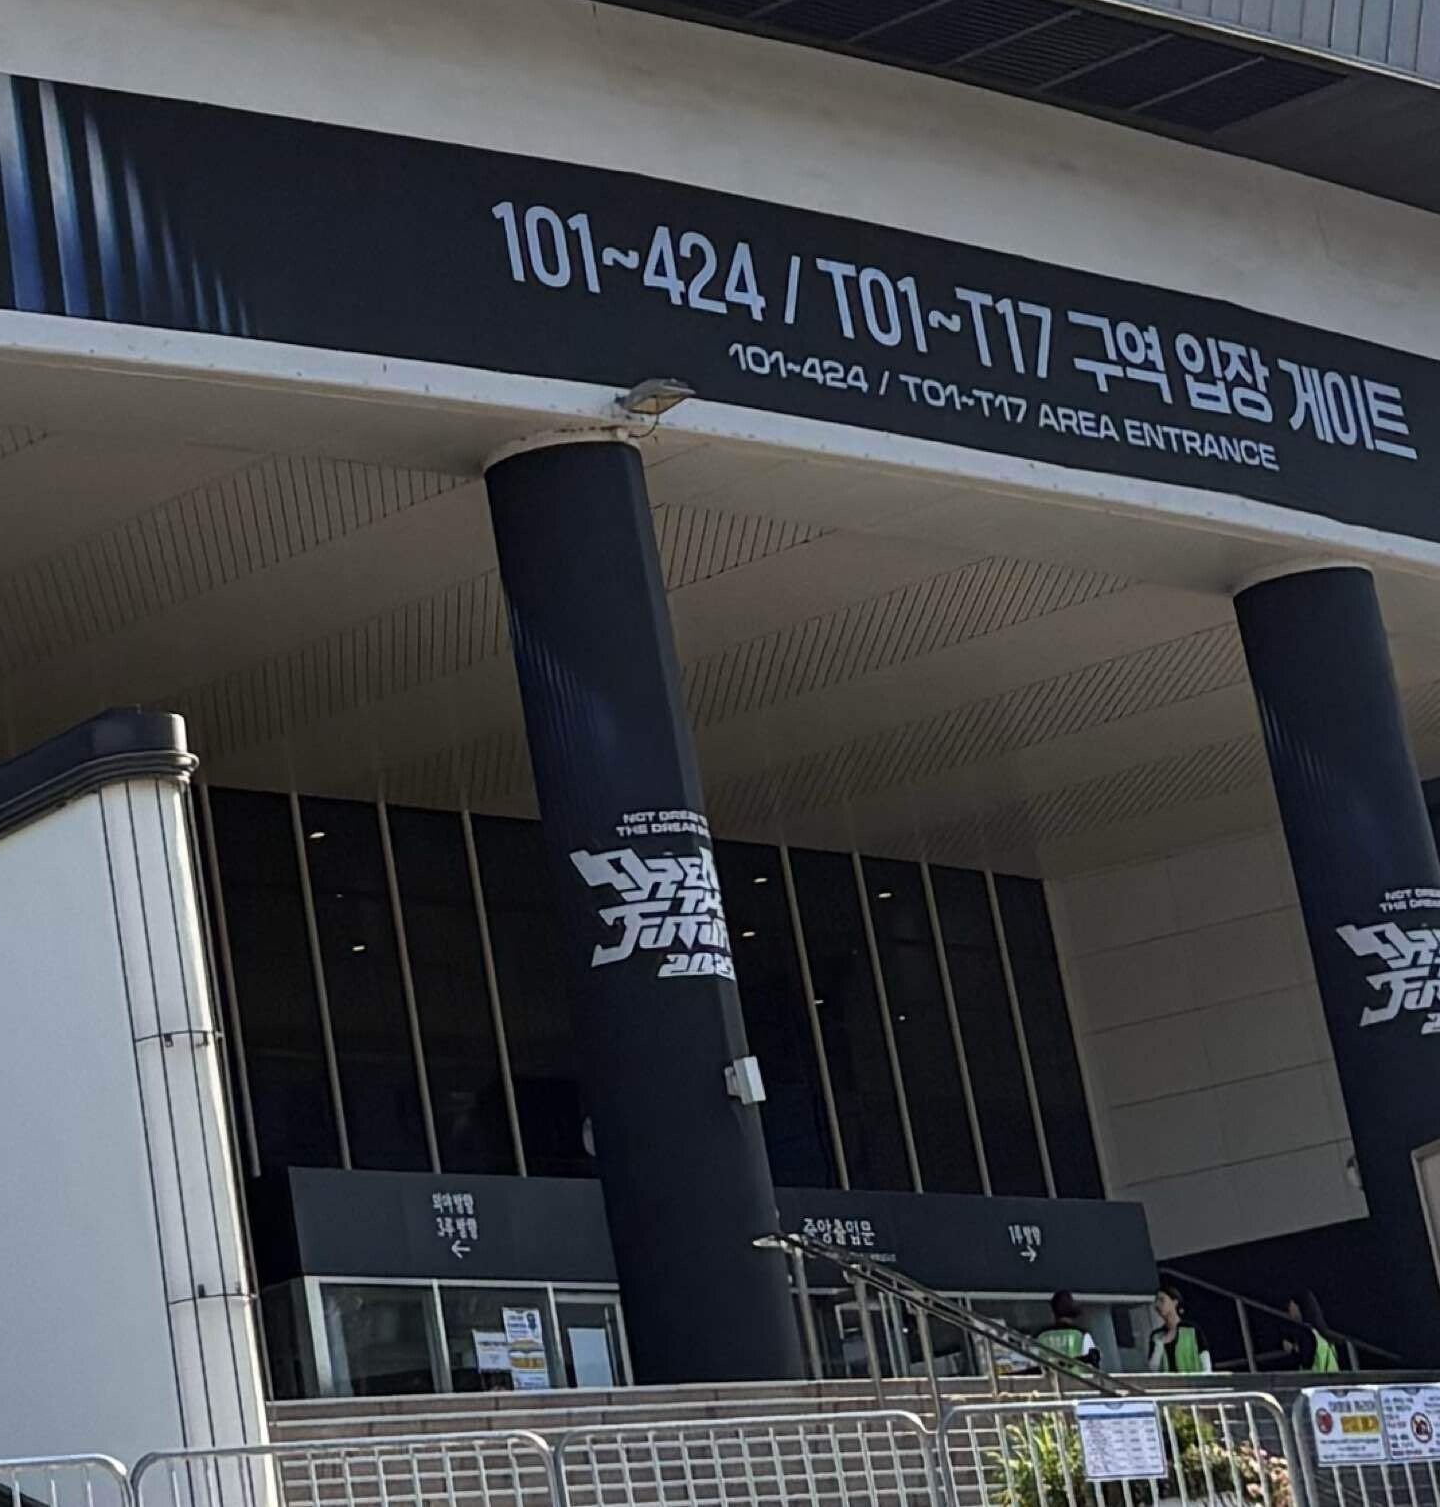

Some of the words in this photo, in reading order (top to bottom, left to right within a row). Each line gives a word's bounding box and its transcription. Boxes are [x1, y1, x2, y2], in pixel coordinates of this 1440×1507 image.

[492, 201, 766, 321] 101~424
[784, 256, 801, 324] /
[816, 258, 1051, 379] T01~T17
[1068, 310, 1173, 404] 구역
[1175, 334, 1274, 423] 입장
[1279, 359, 1417, 460] 게이트
[729, 343, 868, 393] 101~424
[879, 371, 890, 396] /
[899, 373, 1027, 423] T01~T17
[1039, 404, 1119, 441] AREA
[1124, 419, 1280, 471] ENTRANCE
